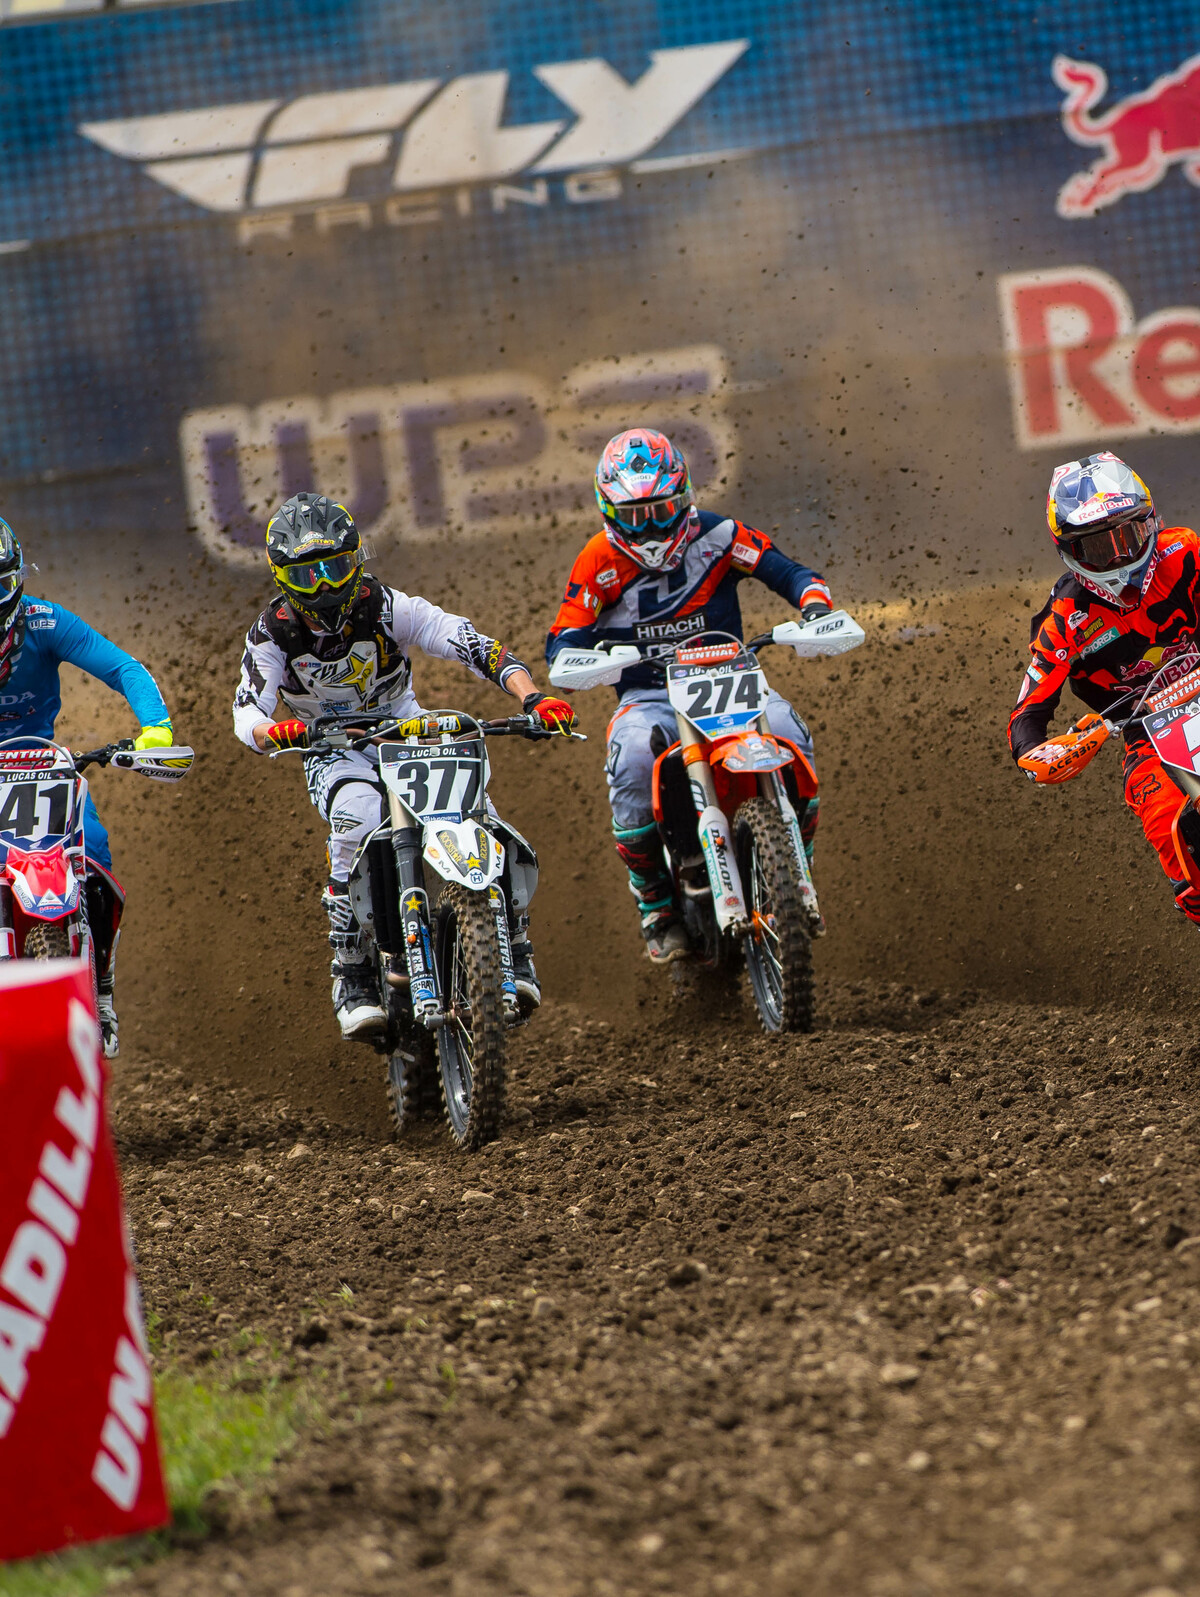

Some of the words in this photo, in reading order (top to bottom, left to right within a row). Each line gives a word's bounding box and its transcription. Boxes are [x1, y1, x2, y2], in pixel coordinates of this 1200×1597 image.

[238, 172, 627, 246] RACING
[182, 345, 740, 572] WPS
[1078, 503, 1105, 522] Red
[1105, 498, 1134, 510] Bull
[28, 619, 56, 631] WPS
[636, 615, 706, 639] HITACHI
[815, 619, 844, 635] UFO
[681, 649, 736, 661] RENTHAL
[1080, 630, 1117, 661] MOTOREX
[563, 657, 599, 666] UFO
[719, 664, 734, 675] OIL
[686, 673, 762, 719] 274
[443, 748, 457, 756] OIL
[1047, 740, 1099, 776] ACERBIS
[6, 772, 36, 782] LUCAS
[37, 770, 52, 780] OIL
[397, 760, 482, 815] 377
[0, 783, 70, 838] 41
